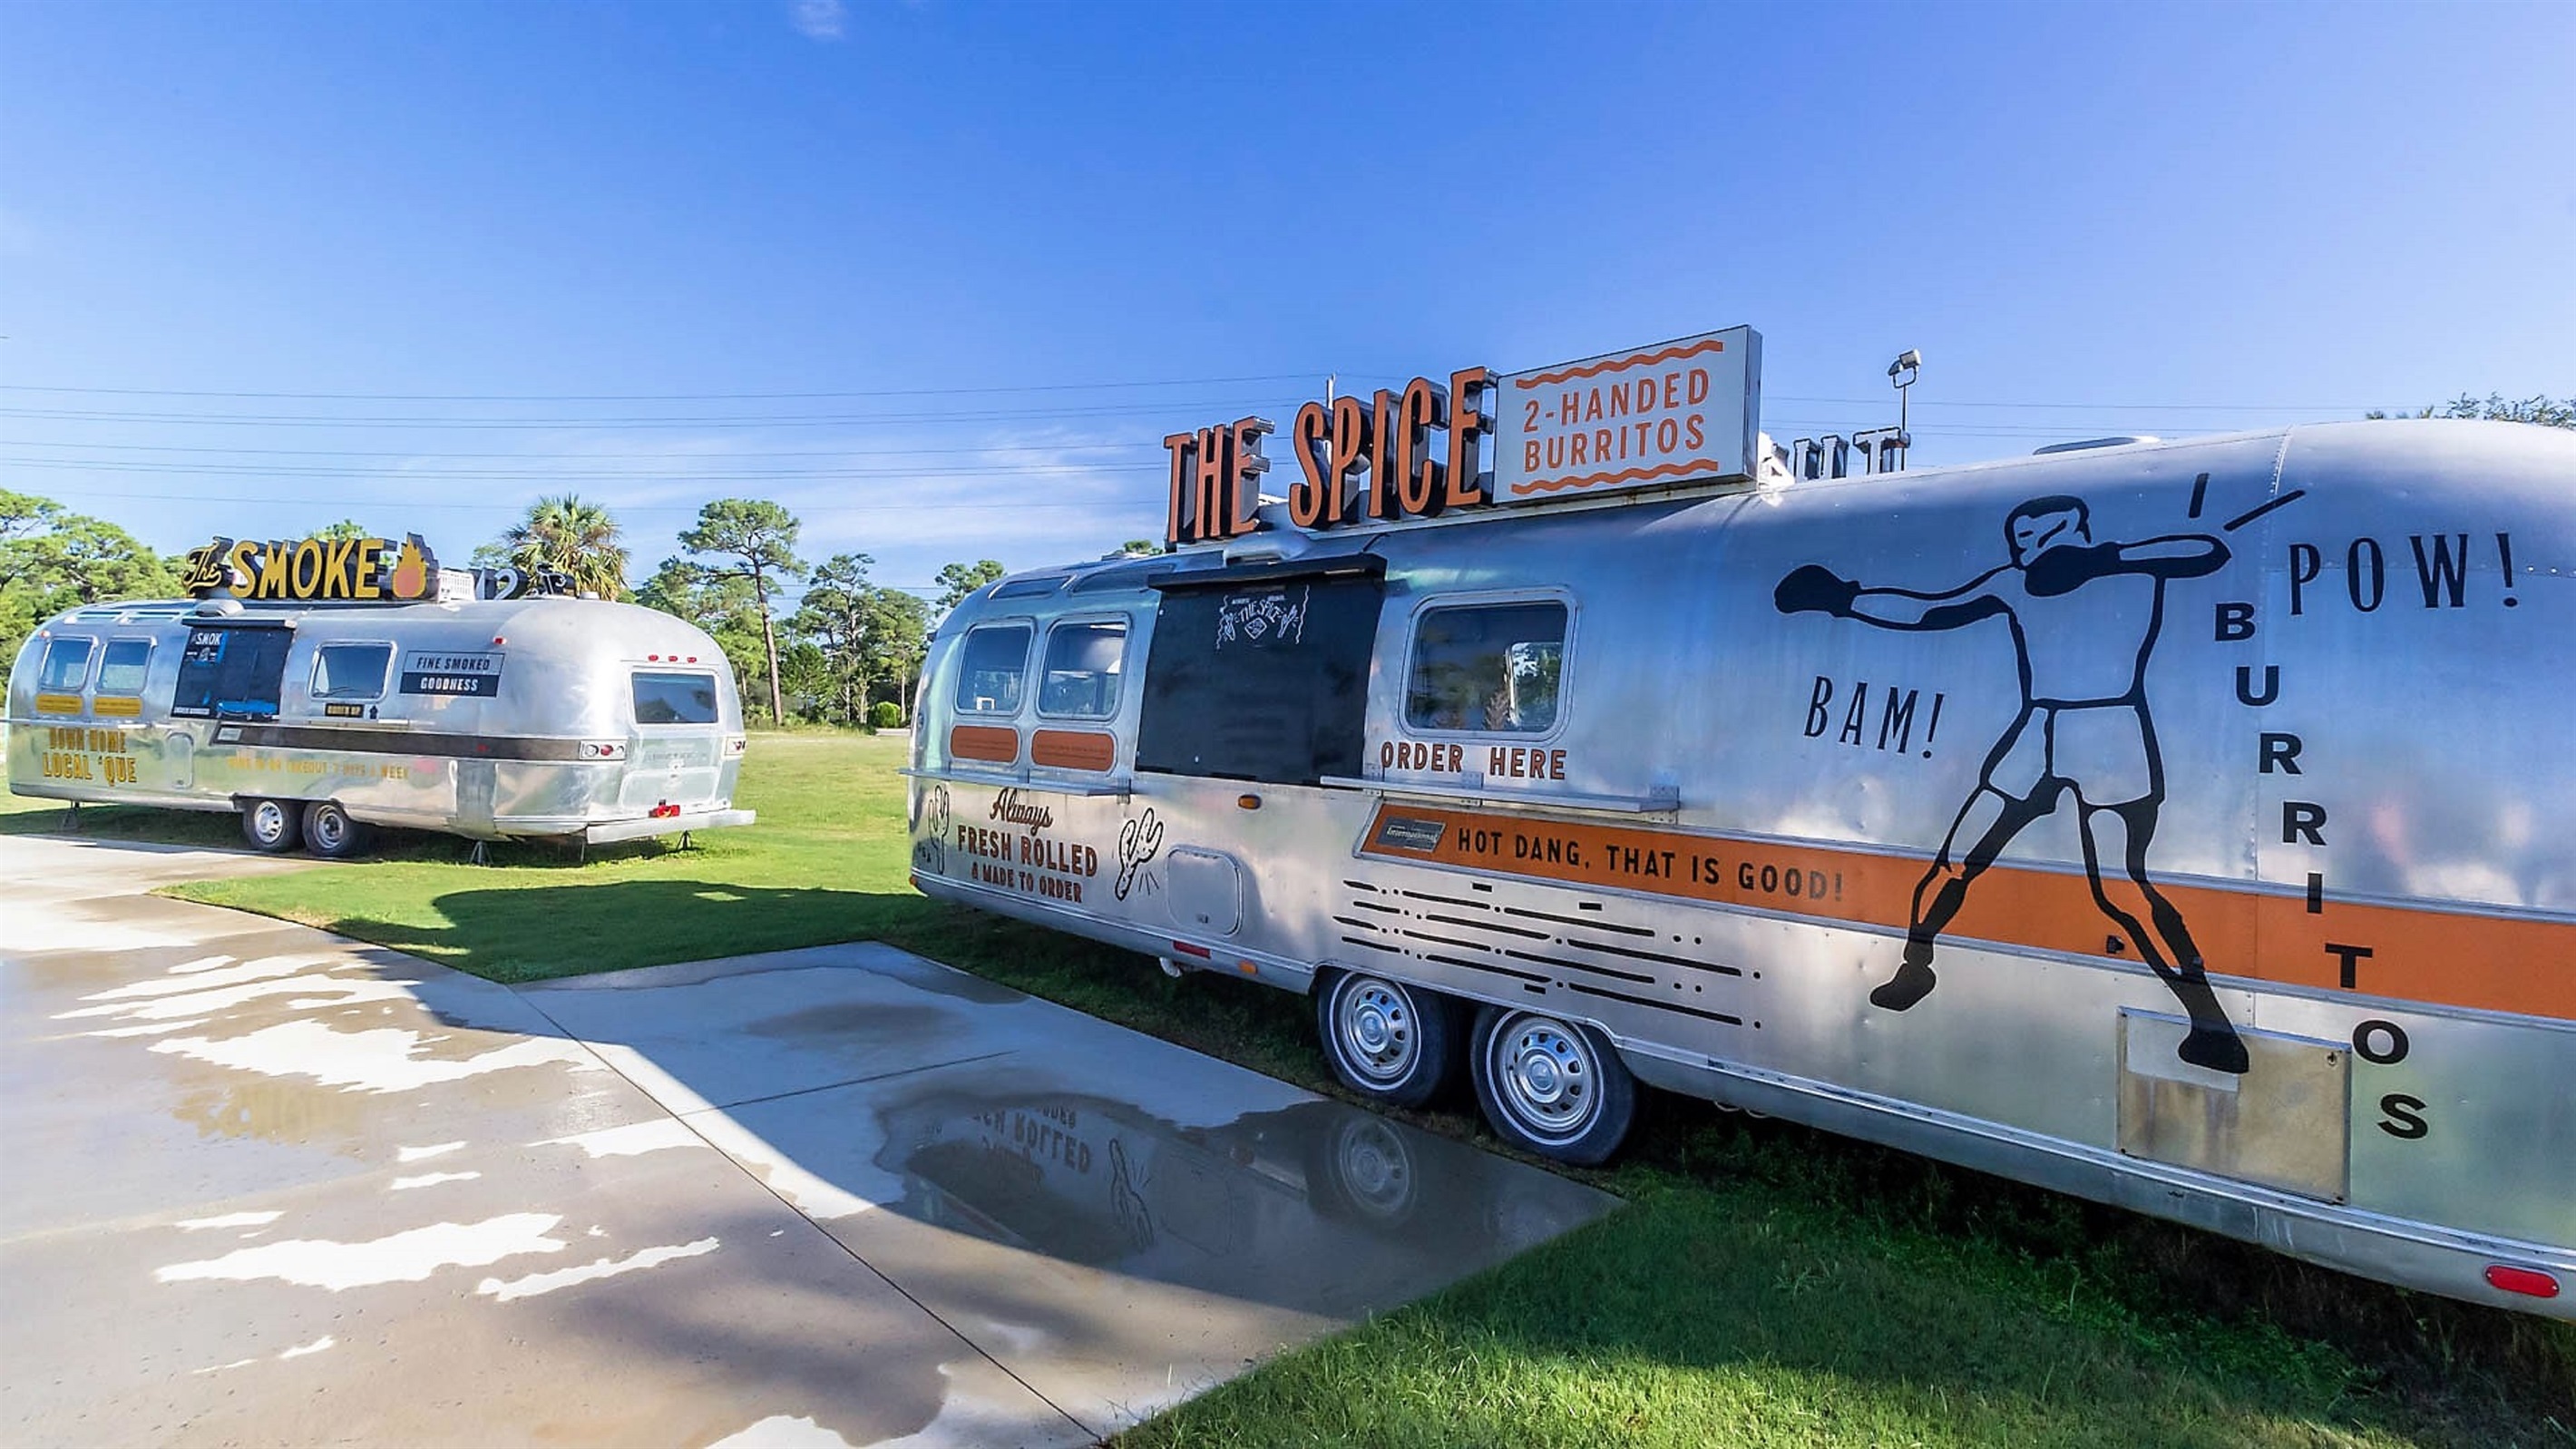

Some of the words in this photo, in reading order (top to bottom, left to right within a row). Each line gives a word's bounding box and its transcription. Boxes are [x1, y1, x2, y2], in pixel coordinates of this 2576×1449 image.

[1524, 367, 1710, 433] 2-HANDED
[1164, 416, 1270, 543] THE
[1289, 366, 1492, 528] SPICE
[1524, 414, 1705, 474] BURRITOS
[182, 535, 224, 598] The
[229, 537, 385, 599] SMOKE
[2290, 532, 2520, 615] POW!
[195, 632, 226, 645] SMOK
[416, 656, 441, 670] FINE
[444, 657, 491, 671] SMOKED
[420, 677, 479, 691] GOODNESS
[1804, 675, 1946, 759] BAM!
[43, 751, 93, 780] LOCAL
[1381, 740, 1464, 773] ORDER
[1488, 747, 1567, 780] HERE
[990, 786, 1054, 837] Always
[958, 825, 1011, 862] FRESH
[1020, 836, 1098, 877] ROLLED
[1459, 827, 1502, 857] HOT
[1516, 836, 1590, 870] DANG,
[1605, 844, 1676, 879] THAT
[1691, 855, 1721, 886] IS
[1738, 862, 1843, 903] GOOD!
[2214, 602, 2429, 1141] BURRITOS
[982, 863, 1014, 888] MADE
[1019, 871, 1034, 892] TO
[1039, 875, 1082, 904] ORDER
